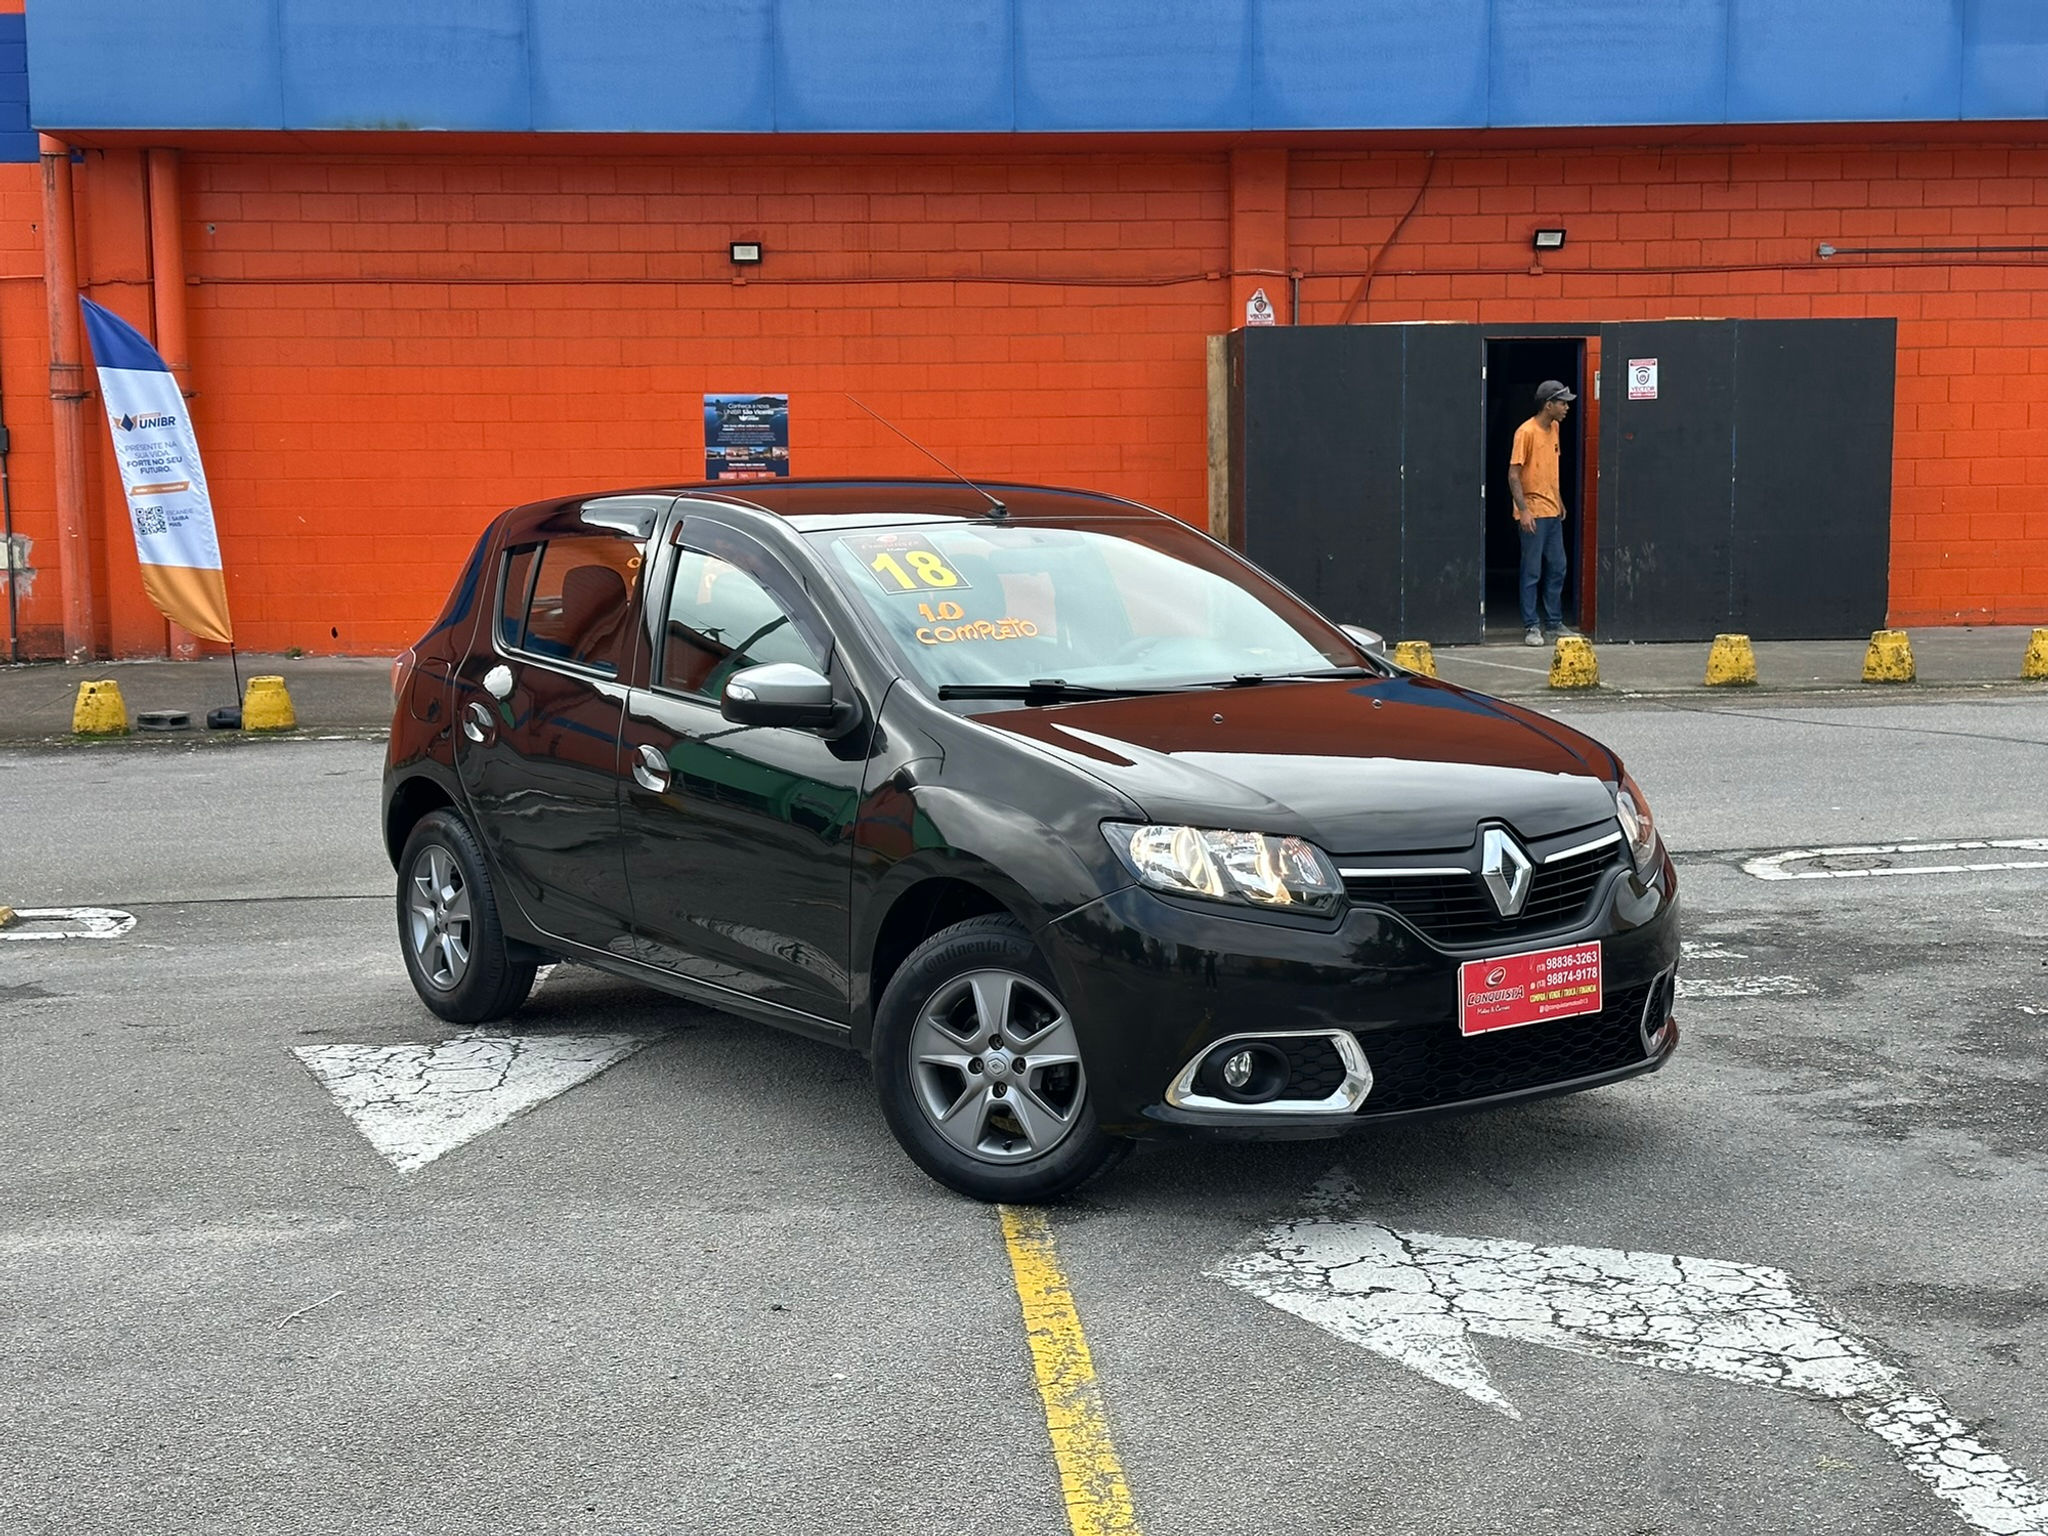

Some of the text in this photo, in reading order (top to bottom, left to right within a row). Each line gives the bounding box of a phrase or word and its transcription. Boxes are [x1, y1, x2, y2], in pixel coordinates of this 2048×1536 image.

[139, 416, 176, 429] UNIBR
[124, 440, 177, 451] PRESENTE NA
[134, 451, 149, 459] SUA
[127, 459, 150, 467] FORTE
[166, 456, 182, 464] SEU
[871, 550, 958, 589] 18
[916, 616, 1037, 645] COMPLETO
[1546, 951, 1597, 970] 98836-3263
[1546, 967, 1597, 986] 98874-9178
[1467, 984, 1524, 1007] CONQUISTA
